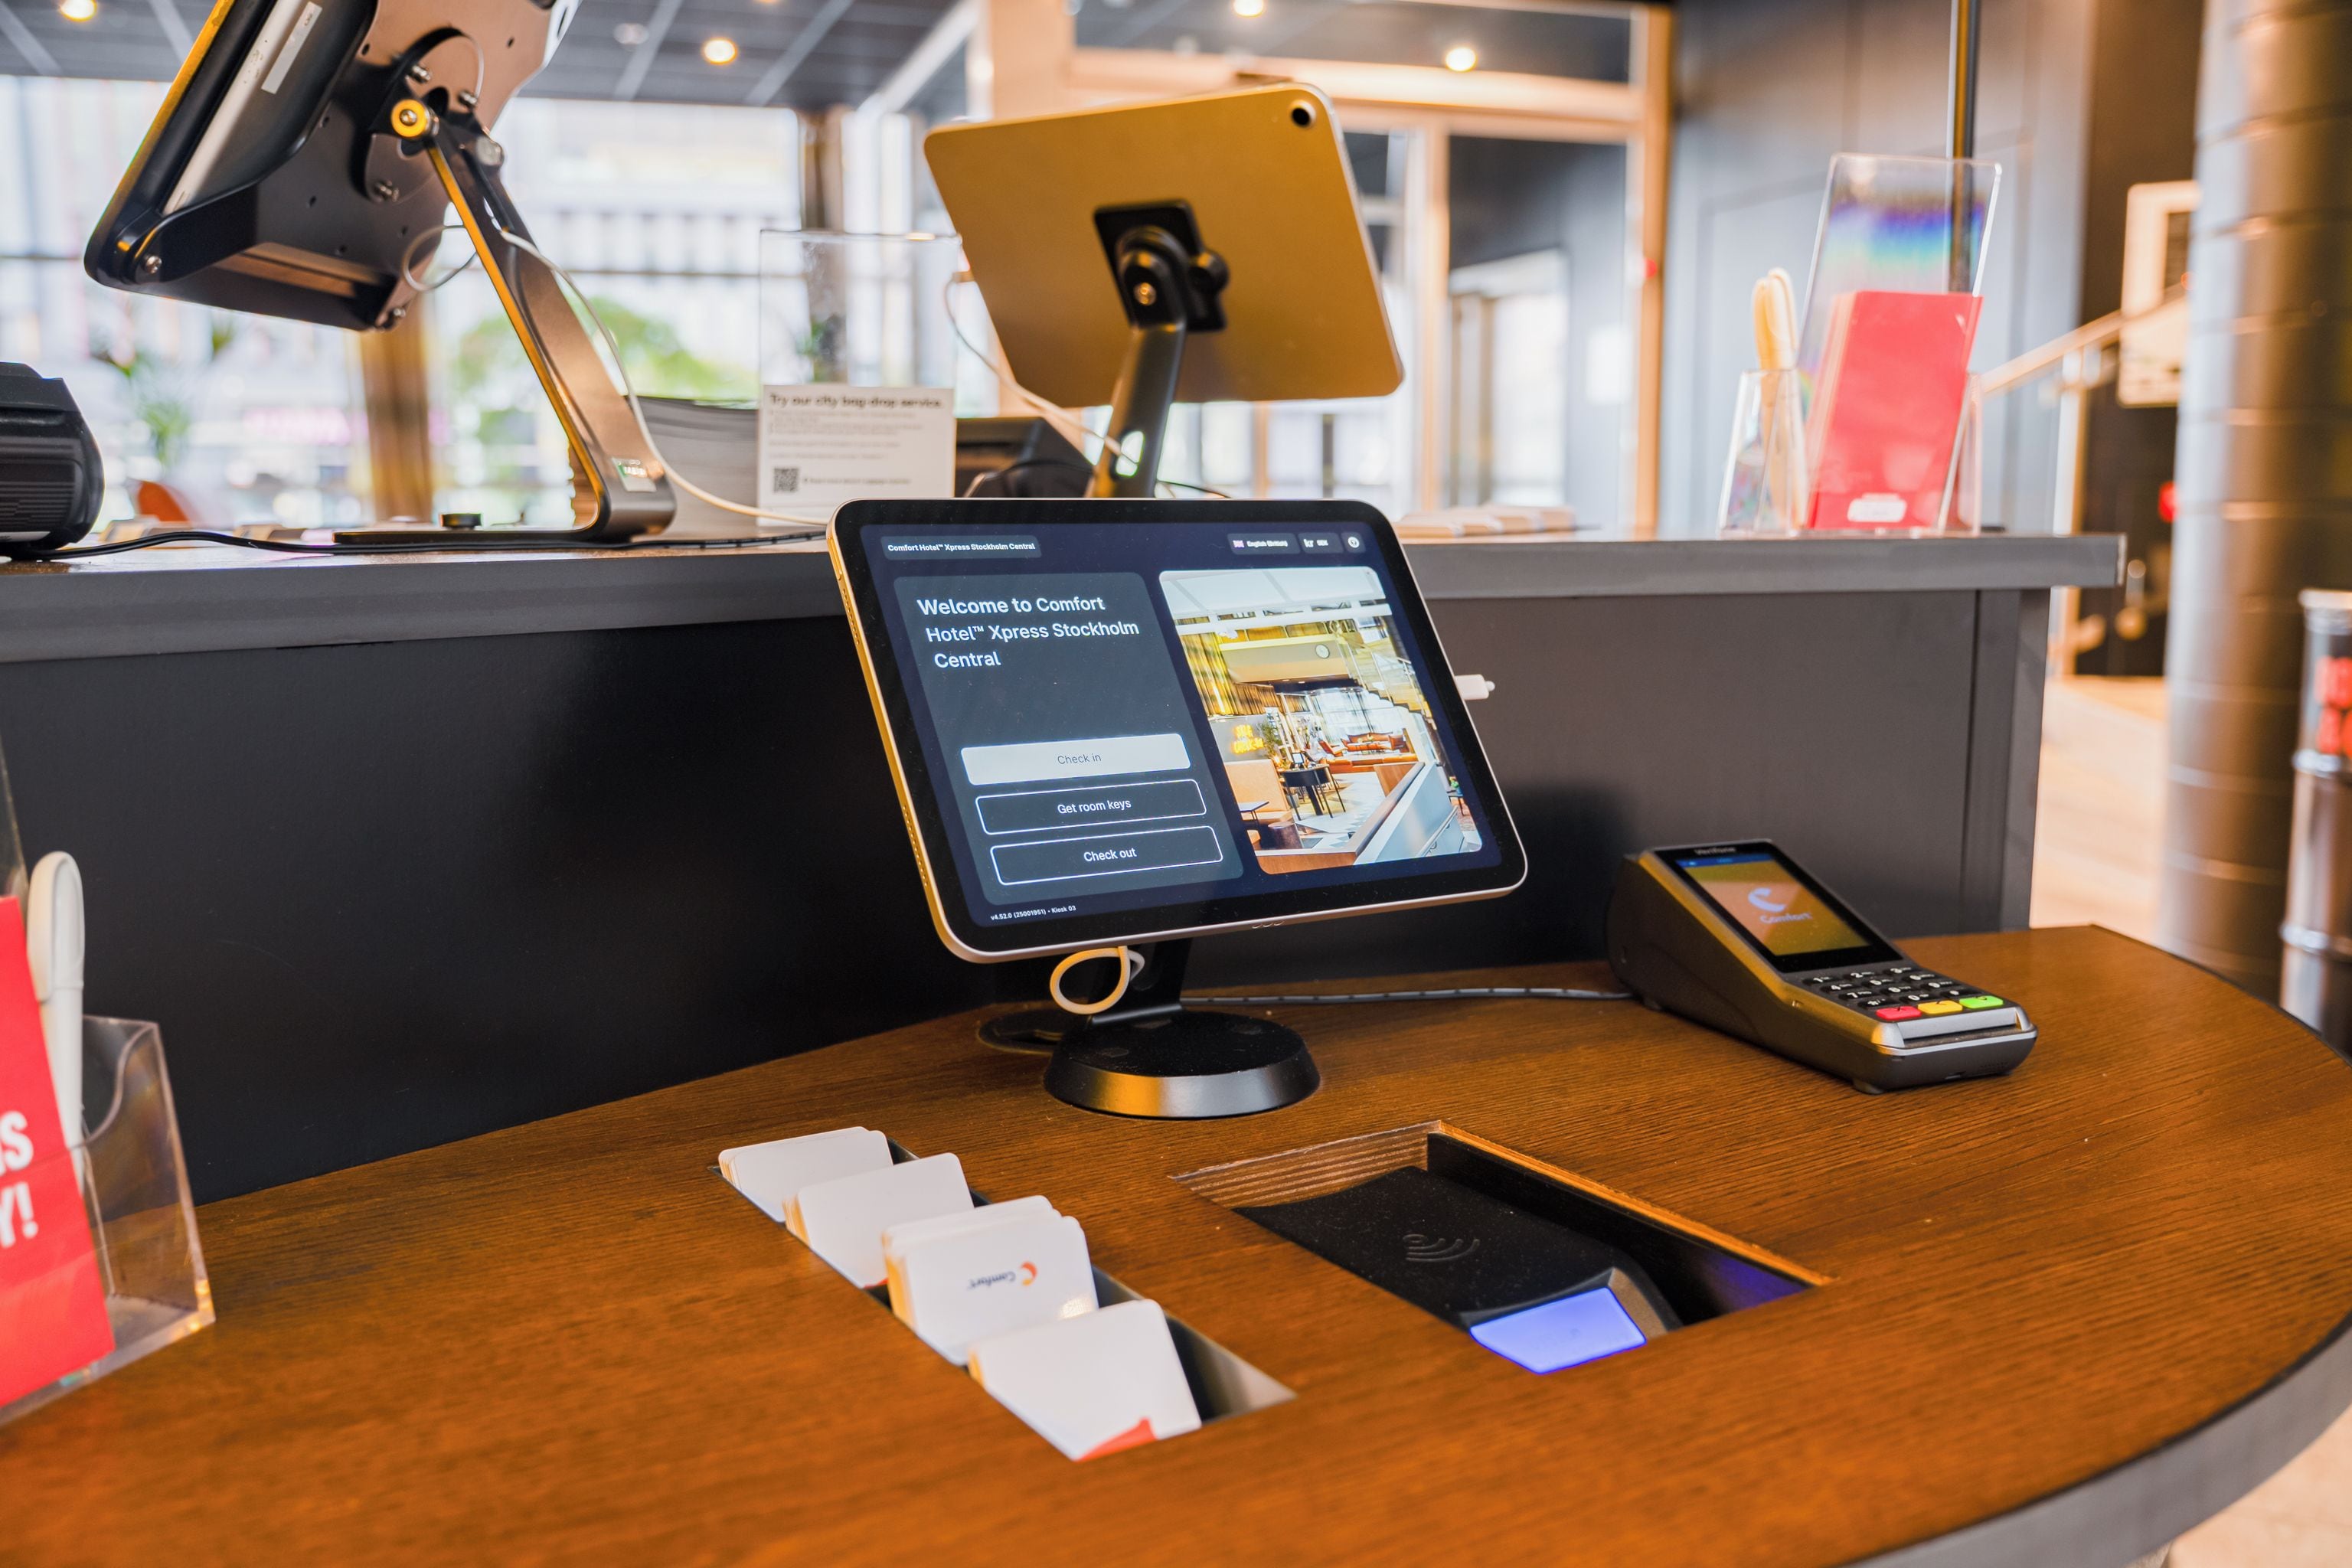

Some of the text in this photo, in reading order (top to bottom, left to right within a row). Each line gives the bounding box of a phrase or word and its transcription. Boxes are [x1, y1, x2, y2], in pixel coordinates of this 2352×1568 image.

[770, 393, 788, 409] Try
[792, 396, 812, 406] our
[816, 394, 838, 409] city
[900, 397, 942, 408] service
[944, 544, 971, 552] Xpress
[971, 543, 1008, 551] Stockholm
[916, 596, 1106, 615] Welcome to Comfort
[925, 621, 1140, 643] Hotel™ Xpress Stockholm
[934, 651, 1001, 668] Central
[1057, 753, 1102, 765] Check in
[1057, 799, 1132, 815] Get room keys
[1083, 847, 1138, 863] Check out
[990, 912, 1012, 921] v4.52.0
[1051, 906, 1067, 914] Kiosk
[0, 1109, 34, 1177] S
